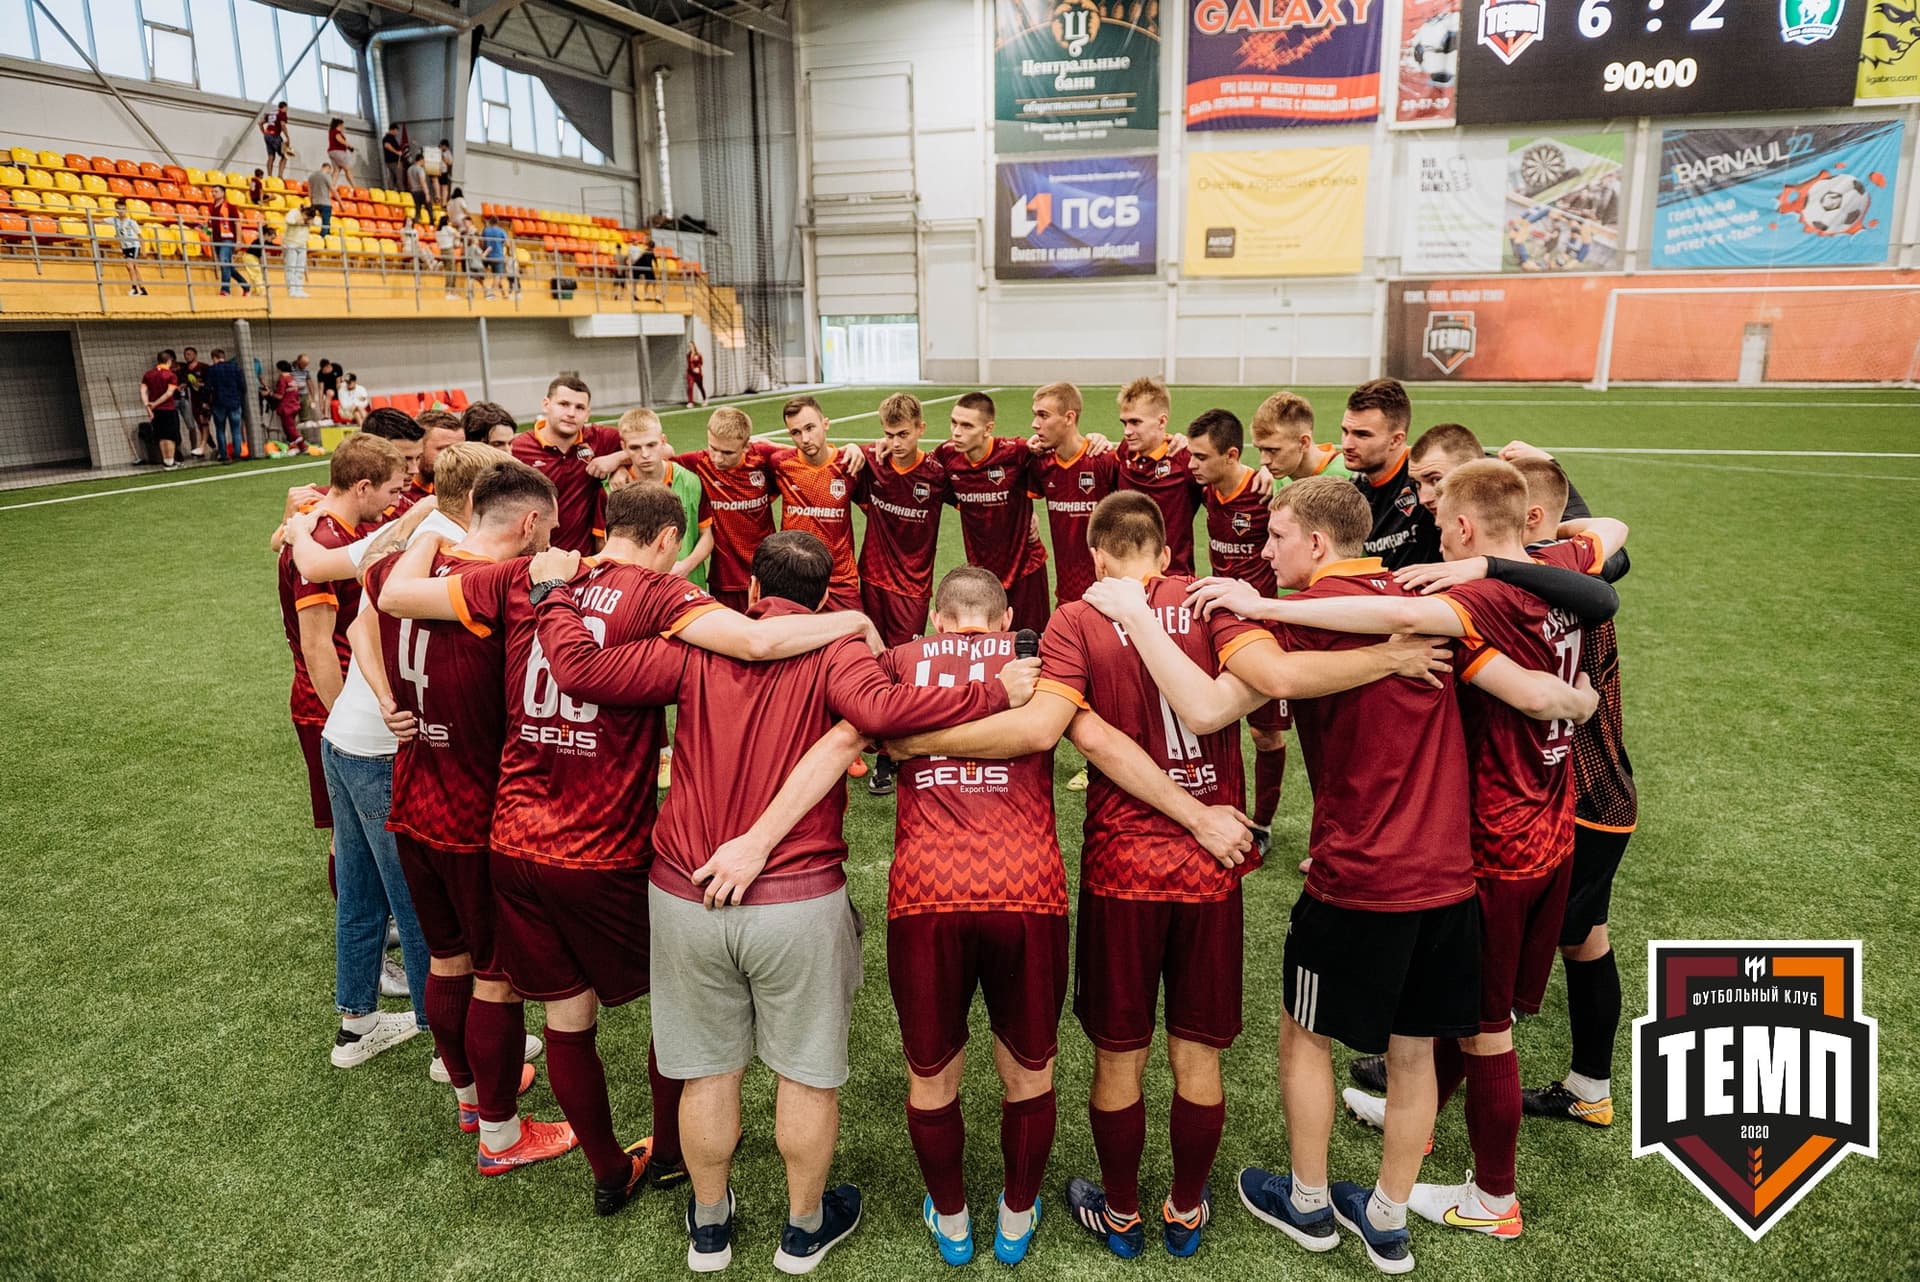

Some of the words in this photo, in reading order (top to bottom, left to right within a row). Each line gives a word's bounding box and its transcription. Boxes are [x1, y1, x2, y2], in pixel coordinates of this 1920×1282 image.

[1194, 0, 1372, 35] GALAXY
[1578, 0, 1613, 38] 6
[1690, 0, 1725, 31] 2
[1022, 56, 1131, 77] Центральные
[1604, 57, 1698, 93] 90:00
[1055, 74, 1096, 91] бани
[1062, 195, 1140, 229] ПСБ
[1011, 247, 1047, 263] Вместе
[922, 638, 1011, 661] МАРКОВ
[398, 618, 430, 715] 4
[520, 723, 597, 750] SEUS
[577, 748, 597, 758] Union
[915, 762, 1008, 790] SEUS
[960, 785, 985, 794] Export
[986, 784, 1008, 793] Union
